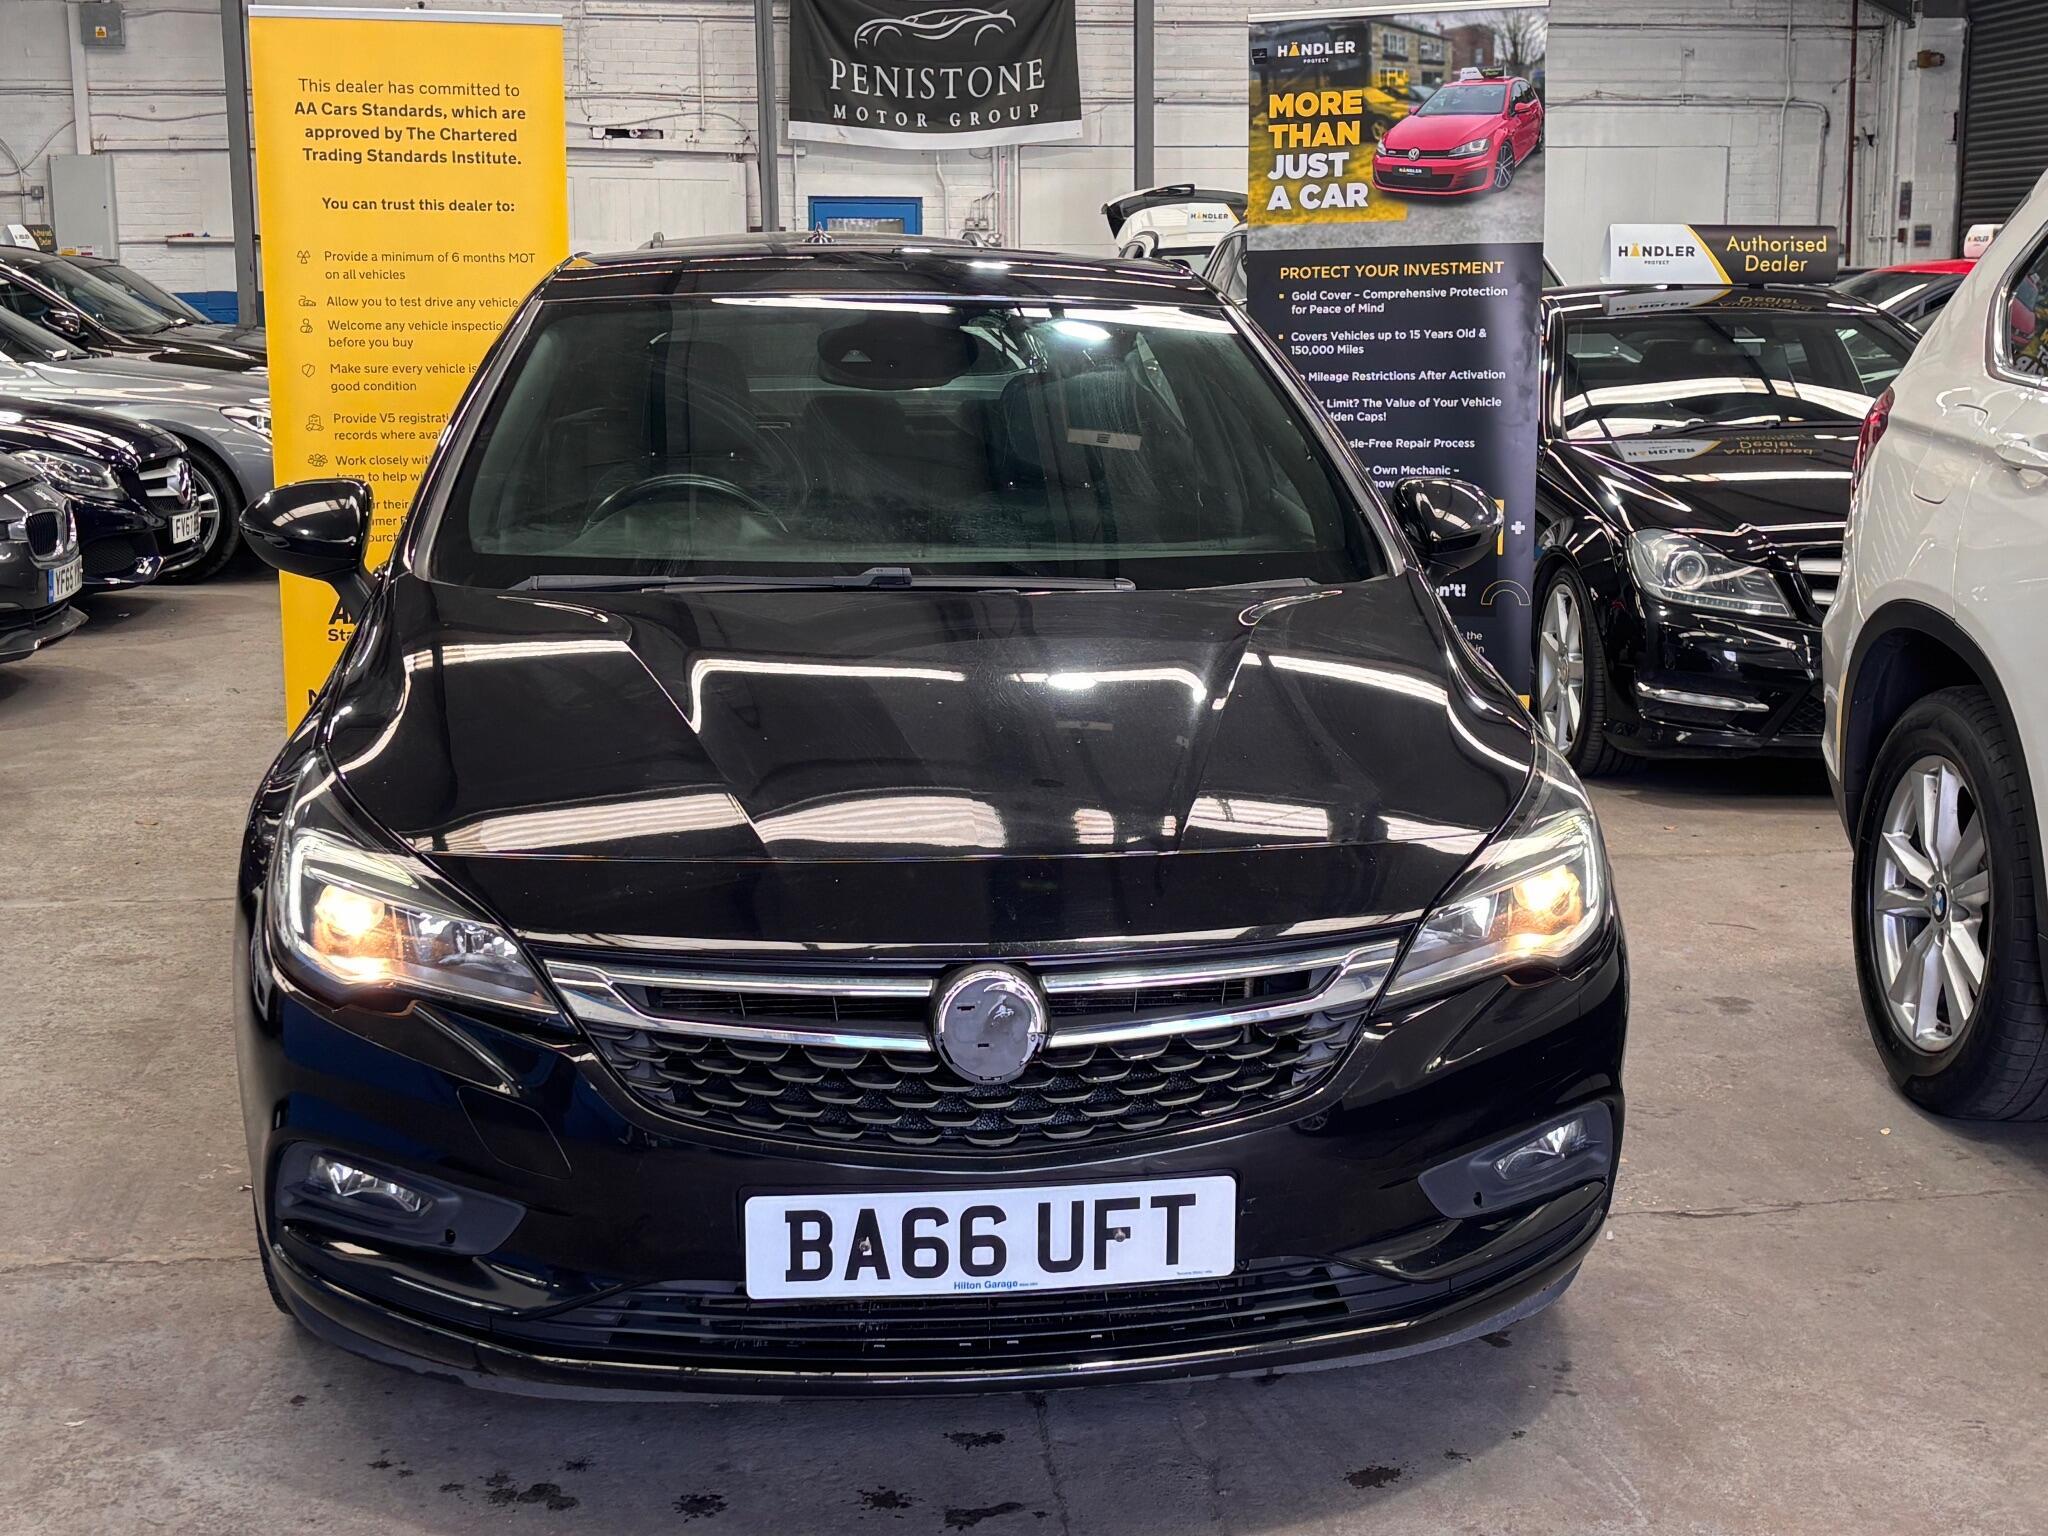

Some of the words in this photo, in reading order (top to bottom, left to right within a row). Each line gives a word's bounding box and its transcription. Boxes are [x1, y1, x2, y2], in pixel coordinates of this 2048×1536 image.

[830, 58, 1045, 99] PENISTONE
[298, 78, 331, 93] This
[336, 79, 384, 94] dealer
[388, 80, 414, 94] has
[419, 82, 500, 97] committed
[505, 84, 520, 97] to
[1269, 89, 1363, 119] MORE
[294, 102, 317, 115] AA
[321, 102, 357, 116] Cars
[362, 103, 448, 119] Standards,
[452, 104, 497, 119] which
[502, 108, 526, 120] are
[833, 104, 927, 127] MOTOR
[950, 103, 1039, 127] GROUP
[305, 126, 380, 141] approved
[384, 126, 402, 142] by
[406, 127, 436, 140] The
[440, 127, 517, 142] Chartered
[1268, 120, 1361, 149] THAN
[303, 148, 362, 164] Trading
[367, 148, 447, 163] Standards
[452, 150, 522, 165] Institute.
[1267, 152, 1349, 180] JUST
[1266, 185, 1292, 211] A
[1299, 183, 1369, 210] CAR
[322, 197, 348, 210] You
[352, 200, 377, 210] can
[381, 198, 415, 211] trust
[419, 199, 445, 211] this
[449, 199, 491, 211] dealer
[496, 201, 515, 212] to:
[1726, 235, 1827, 253] Authorised
[324, 251, 368, 262] Provide
[371, 254, 378, 262] a
[381, 251, 434, 262] minimum
[438, 252, 449, 263] of
[452, 252, 459, 263] 6
[463, 252, 505, 263] months
[508, 253, 536, 263] MOT
[1745, 255, 1808, 272] Dealer
[325, 271, 340, 279] on
[343, 269, 356, 280] all
[359, 269, 406, 280] vehicles
[1280, 265, 1351, 280] PROTECT
[1355, 264, 1399, 278] YOUR
[1404, 261, 1504, 276] INVESTMENT
[1292, 291, 1317, 301] Gold
[1319, 291, 1351, 301] Cover
[1363, 288, 1447, 301] Comprehensive
[1449, 286, 1508, 297] Protection
[326, 296, 358, 307] Allow
[361, 298, 382, 310] you
[385, 297, 397, 307] to
[400, 298, 422, 307] test
[425, 296, 453, 307] drive
[456, 299, 476, 310] any
[478, 297, 518, 308] vehicle
[1291, 304, 1307, 315] for
[1309, 304, 1341, 315] Peace
[1344, 303, 1356, 314] of
[1358, 303, 1384, 313] Mind
[328, 320, 382, 331] Welcome
[385, 322, 405, 334] any
[408, 320, 448, 331] vehicle
[451, 321, 503, 334] inspectio
[1291, 332, 1327, 342] Covers
[1330, 331, 1375, 341] Vehicles
[1378, 332, 1392, 343] up
[1394, 331, 1406, 340] to
[1409, 330, 1421, 340] 15
[1423, 329, 1453, 339] Years
[1456, 328, 1476, 339] Old
[1478, 329, 1487, 338] &
[328, 337, 366, 348] before
[369, 339, 389, 350] you
[392, 337, 413, 349] buy
[1291, 345, 1334, 356] 150,000
[1337, 344, 1364, 354] Miles
[330, 363, 361, 374] Make
[364, 366, 390, 374] sure
[393, 365, 423, 376] every
[426, 363, 465, 374] vehicle
[469, 365, 477, 374] is
[1308, 372, 1349, 383] Mileage
[1352, 371, 1415, 381] Restrictions
[1418, 370, 1447, 380] After
[1449, 370, 1505, 380] Activation
[331, 381, 360, 393] good
[363, 381, 417, 392] condition
[1326, 398, 1359, 408] Limit?
[1362, 398, 1383, 408] The
[1385, 398, 1416, 408] Value
[1418, 397, 1430, 407] of
[1433, 398, 1459, 407] Your
[1461, 397, 1502, 407] Vehicle
[333, 413, 376, 423] Provide
[379, 413, 395, 423] V5
[399, 413, 449, 425] registrati
[1356, 412, 1387, 423] Caps!
[334, 430, 377, 440] records
[381, 431, 416, 440] where
[419, 429, 441, 440] avai
[1350, 438, 1393, 449] sle-Free
[1396, 438, 1430, 450] Repair
[1433, 438, 1475, 448] Process
[336, 456, 366, 465] Work
[369, 456, 409, 467] closely
[411, 455, 429, 465] wit
[1373, 465, 1398, 475] Own
[1400, 465, 1451, 475] Mechanic
[368, 472, 380, 482] to
[383, 472, 408, 483] help
[410, 472, 423, 481] wi
[383, 499, 409, 509] their
[1466, 631, 1483, 640] the
[784, 1204, 1007, 1282] BA66
[1037, 1193, 1196, 1274] UFT
[953, 1280, 981, 1290] Hilton
[984, 1280, 1018, 1290] Garage
